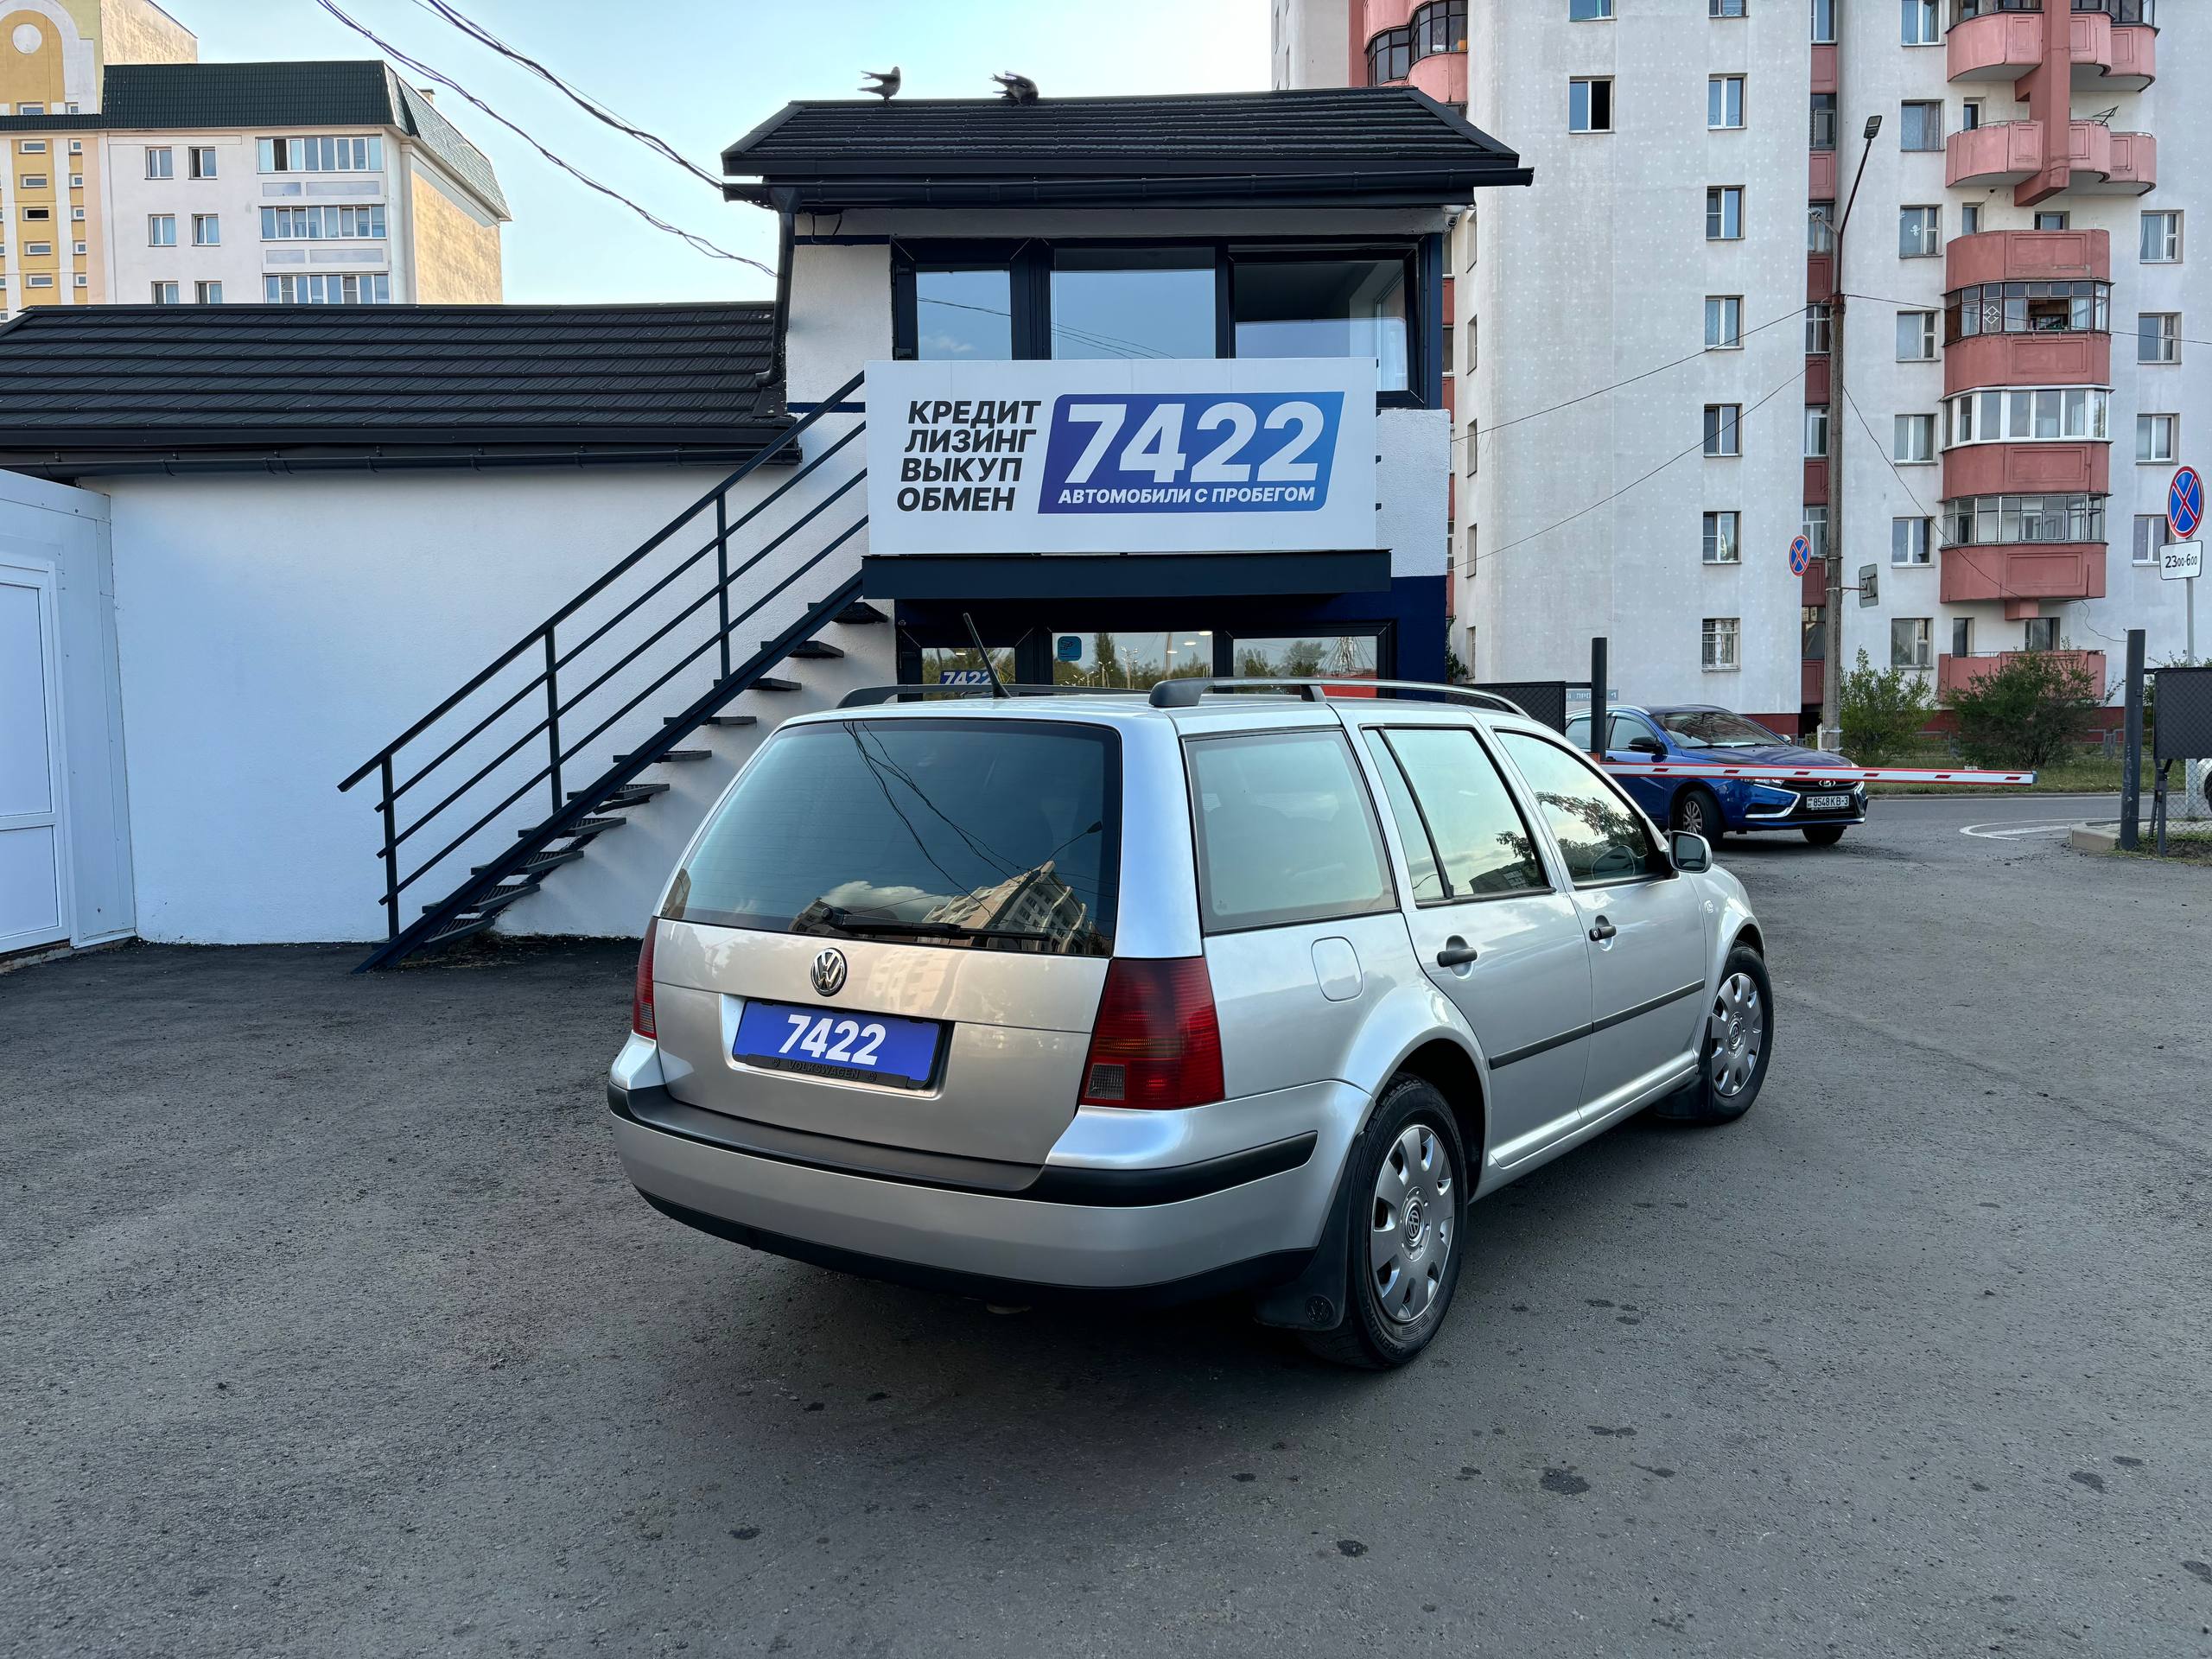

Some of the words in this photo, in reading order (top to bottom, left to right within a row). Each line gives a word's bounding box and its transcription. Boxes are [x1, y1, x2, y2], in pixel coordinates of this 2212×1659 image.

[907, 400, 1041, 429] КРЕДИТ
[905, 429, 1038, 453] ЛИЗИНГ
[1065, 402, 1325, 483] 7422
[900, 458, 1021, 482] ВЫКУП
[896, 486, 1014, 512] ОБМЕН
[1058, 487, 1190, 504] АВТОМОБИЛИ
[1194, 488, 1208, 503] С
[1211, 486, 1315, 503] ПРОБЕГОМ
[779, 1014, 887, 1065] 7422
[787, 1061, 860, 1080] VOLKSWAGEN
